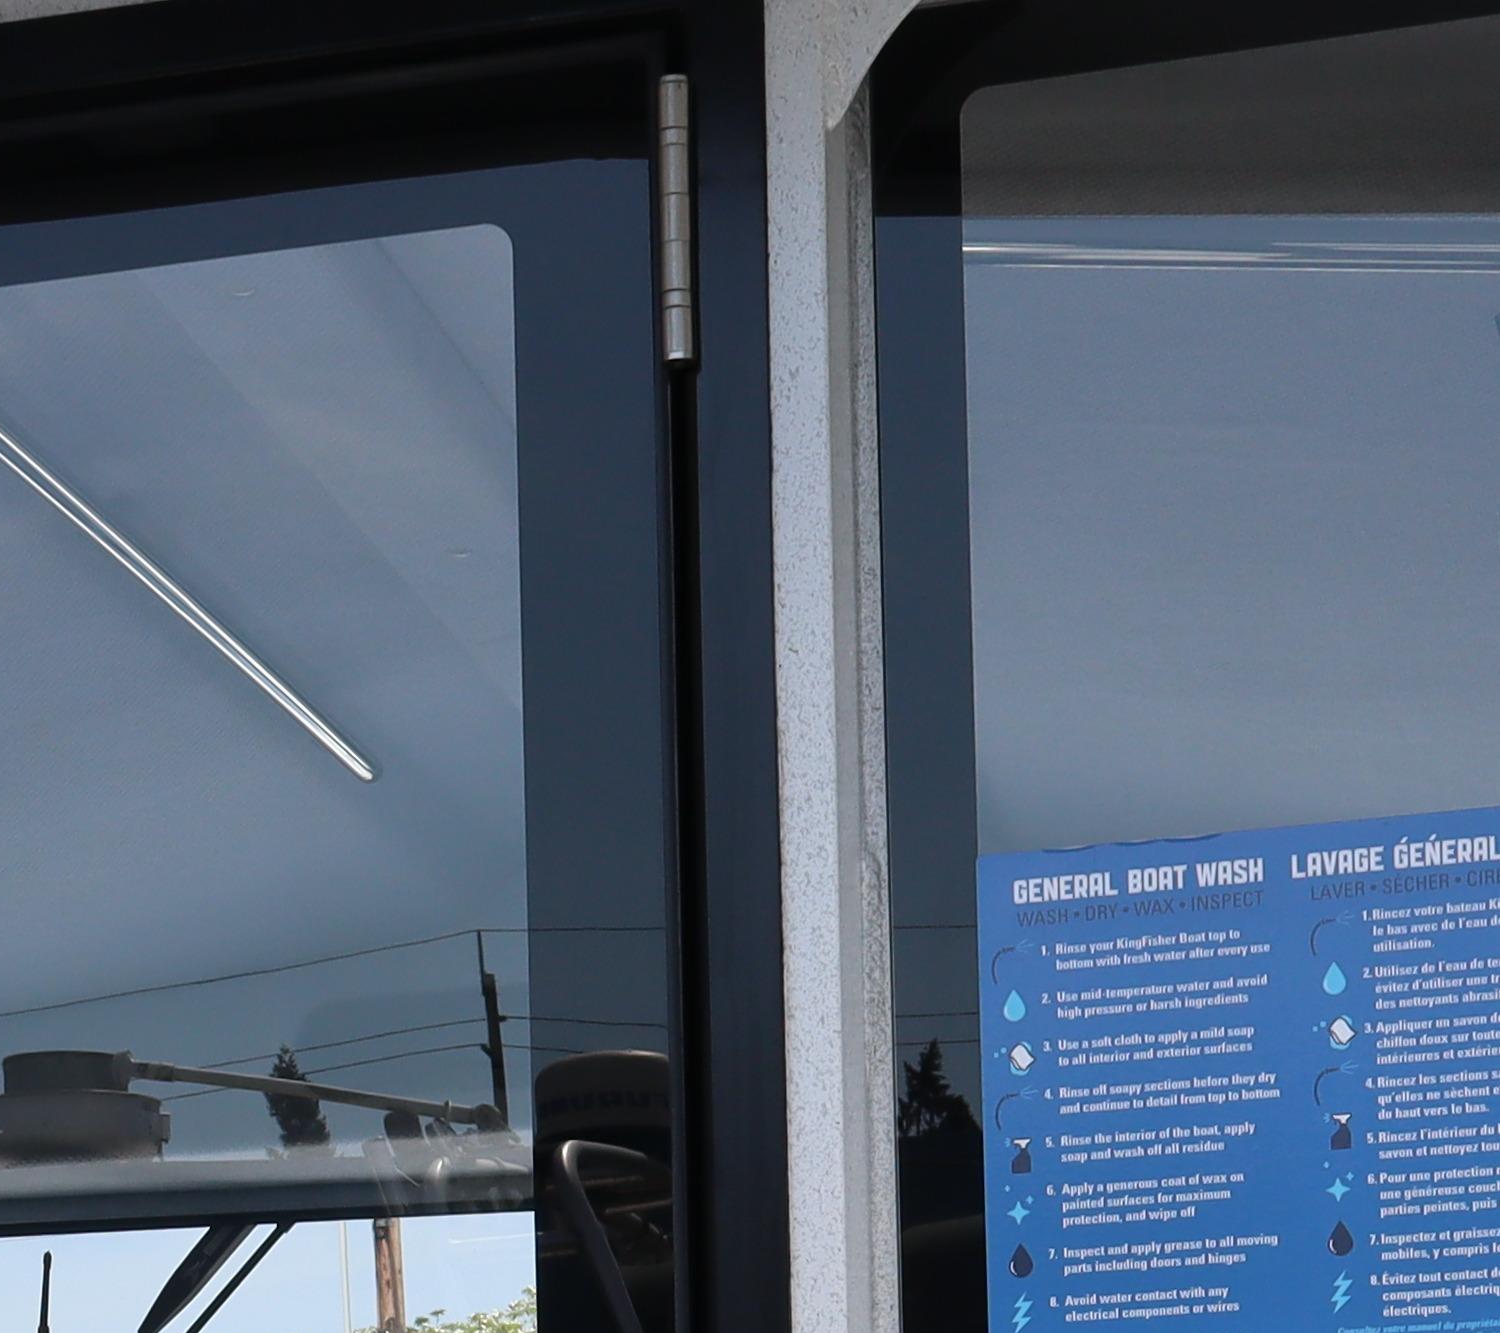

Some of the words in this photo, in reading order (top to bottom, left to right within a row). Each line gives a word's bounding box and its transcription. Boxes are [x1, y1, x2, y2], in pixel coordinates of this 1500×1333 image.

[1291, 846, 1384, 878] LAVAGE
[1013, 872, 1118, 904] GENERAL
[1127, 864, 1187, 894] BOAT
[1195, 857, 1263, 888] WASH
[1310, 880, 1364, 901] LAVER
[1382, 866, 1449, 895] SÉCHER
[1016, 907, 1071, 927] WASH
[1084, 902, 1118, 921] DRY
[1133, 897, 1174, 917] WAX
[1191, 889, 1264, 912] INSPECT
[1055, 941, 1086, 954] Rinse
[1089, 941, 1114, 954] your
[1116, 933, 1176, 952] KingFisher
[1179, 930, 1205, 944] Boat
[1208, 929, 1226, 944] top
[1229, 927, 1240, 939] to
[1373, 936, 1434, 952] utilisation.
[1055, 956, 1093, 970] bottom
[1095, 954, 1120, 967] with
[1123, 951, 1151, 964] fresh
[1153, 948, 1186, 962] water
[1189, 946, 1214, 959] after
[1217, 946, 1248, 959] every
[1250, 944, 1270, 954] use
[1056, 990, 1078, 1002] Use
[1080, 982, 1173, 1003] mid-temperature
[1176, 979, 1210, 992] water
[1212, 977, 1233, 989] and
[1236, 974, 1267, 987] avoid
[1466, 976, 1487, 986] une
[1057, 1006, 1081, 1021] high
[1084, 1004, 1133, 1019] pressure
[1136, 1003, 1147, 1012] or
[1149, 997, 1181, 1011] harsh
[1184, 992, 1248, 1011] ingredients
[1375, 997, 1396, 1009] des
[1398, 992, 1459, 1010] nettoyants
[1376, 1034, 1416, 1048] chiffon
[1419, 1031, 1448, 1045] doux
[1451, 1033, 1469, 1042] sur
[1442, 1047, 1454, 1059] et
[1059, 1085, 1090, 1098] Rinse
[1092, 1083, 1107, 1096] off
[1109, 1084, 1141, 1097] soapy
[1144, 1077, 1190, 1092] sections
[1193, 1074, 1229, 1088] before
[1231, 1072, 1255, 1088] they
[1257, 1071, 1276, 1086] dry
[1426, 1091, 1440, 1100] ne
[1059, 1102, 1080, 1114] and
[1082, 1098, 1130, 1112] continue
[1132, 1097, 1143, 1108] to
[1146, 1094, 1177, 1107] detail
[1180, 1092, 1205, 1105] from
[1207, 1091, 1226, 1106] top
[1228, 1090, 1239, 1101] to
[1241, 1087, 1280, 1100] bottom
[1060, 1133, 1091, 1146] Rinse
[1094, 1131, 1112, 1144] the
[1114, 1128, 1156, 1142] interior
[1158, 1127, 1170, 1139] of
[1172, 1126, 1190, 1138] the
[1224, 1121, 1255, 1137] apply
[1060, 1152, 1087, 1165] soap
[1090, 1147, 1111, 1160] and
[1113, 1145, 1144, 1158] wash
[1147, 1144, 1162, 1156] off
[1164, 1143, 1179, 1155] all
[1182, 1139, 1224, 1153] residue
[1378, 1149, 1413, 1159] savon
[1415, 1145, 1427, 1156] et
[1430, 1141, 1478, 1158] nettoyez
[1125, 1210, 1146, 1221] and
[1148, 1208, 1177, 1223] wipe
[1180, 1207, 1195, 1218] off
[1380, 1202, 1420, 1219] parties
[1472, 1197, 1497, 1213] puis
[1063, 1244, 1104, 1261] Inspect
[1107, 1243, 1128, 1256] and
[1130, 1240, 1161, 1257] apply
[1164, 1241, 1202, 1255] grease
[1205, 1237, 1216, 1249] to
[1219, 1236, 1234, 1248] all
[1236, 1233, 1278, 1250] moving
[1063, 1261, 1092, 1277] parts
[1095, 1258, 1147, 1275] including
[1150, 1256, 1181, 1269] doors
[1184, 1254, 1205, 1266] and
[1208, 1251, 1246, 1268] hinges
[1064, 1293, 1096, 1306] Avoid
[1099, 1291, 1132, 1304] water
[1134, 1288, 1177, 1302] contact
[1179, 1286, 1205, 1299] with
[1208, 1288, 1228, 1300] any
[1382, 1285, 1451, 1303] composants
[1065, 1308, 1119, 1322] electrical
[1122, 1304, 1189, 1321] components
[1192, 1306, 1204, 1314] or
[1206, 1301, 1239, 1313] wires
